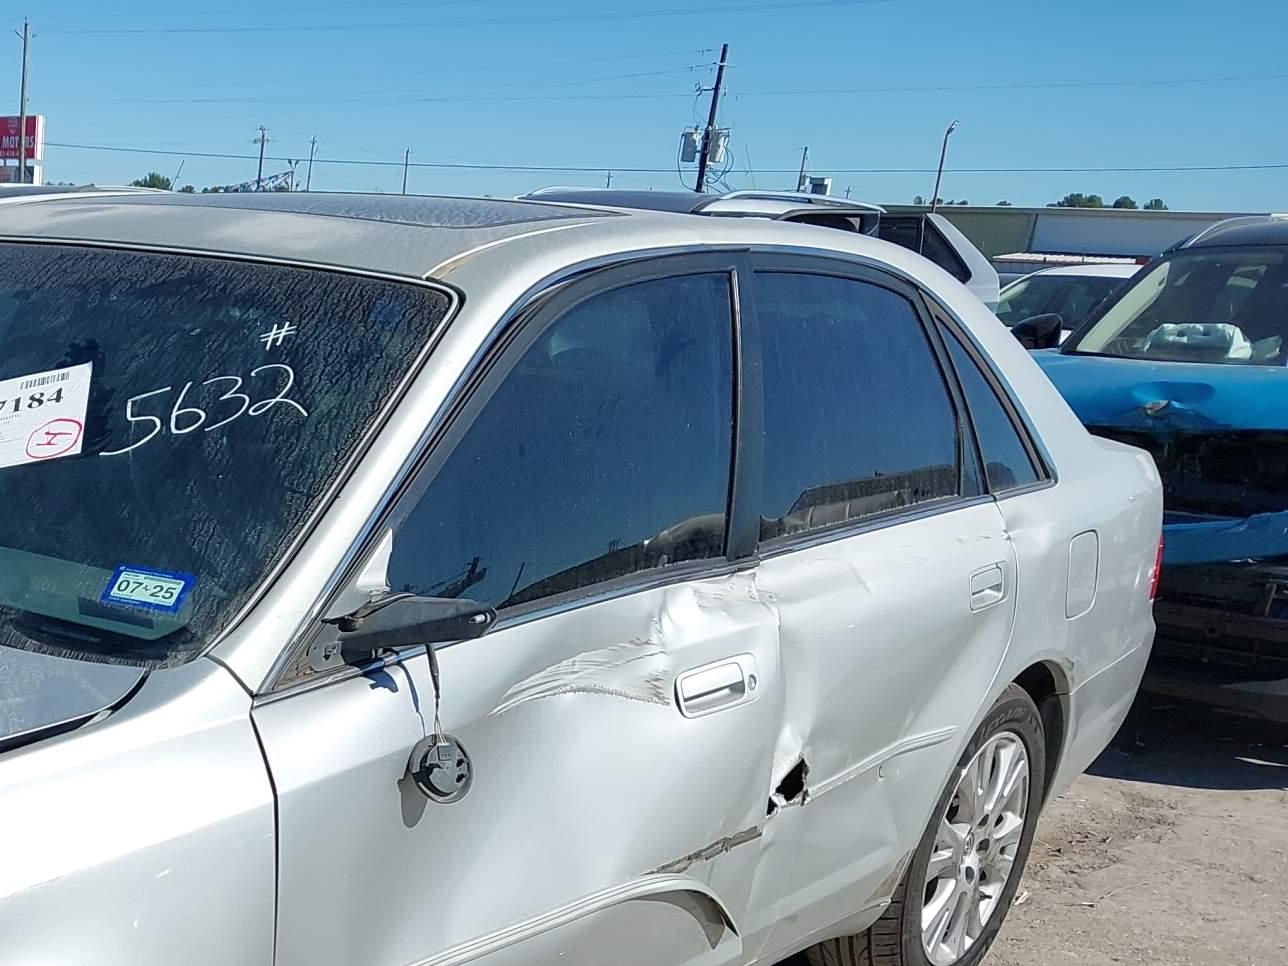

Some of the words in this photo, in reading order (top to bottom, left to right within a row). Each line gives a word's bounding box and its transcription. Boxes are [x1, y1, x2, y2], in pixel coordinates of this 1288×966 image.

[2, 135, 35, 149] MOTRS
[259, 321, 298, 351] #
[98, 363, 309, 456] 5632
[116, 579, 145, 594] 07
[148, 584, 177, 600] 25
